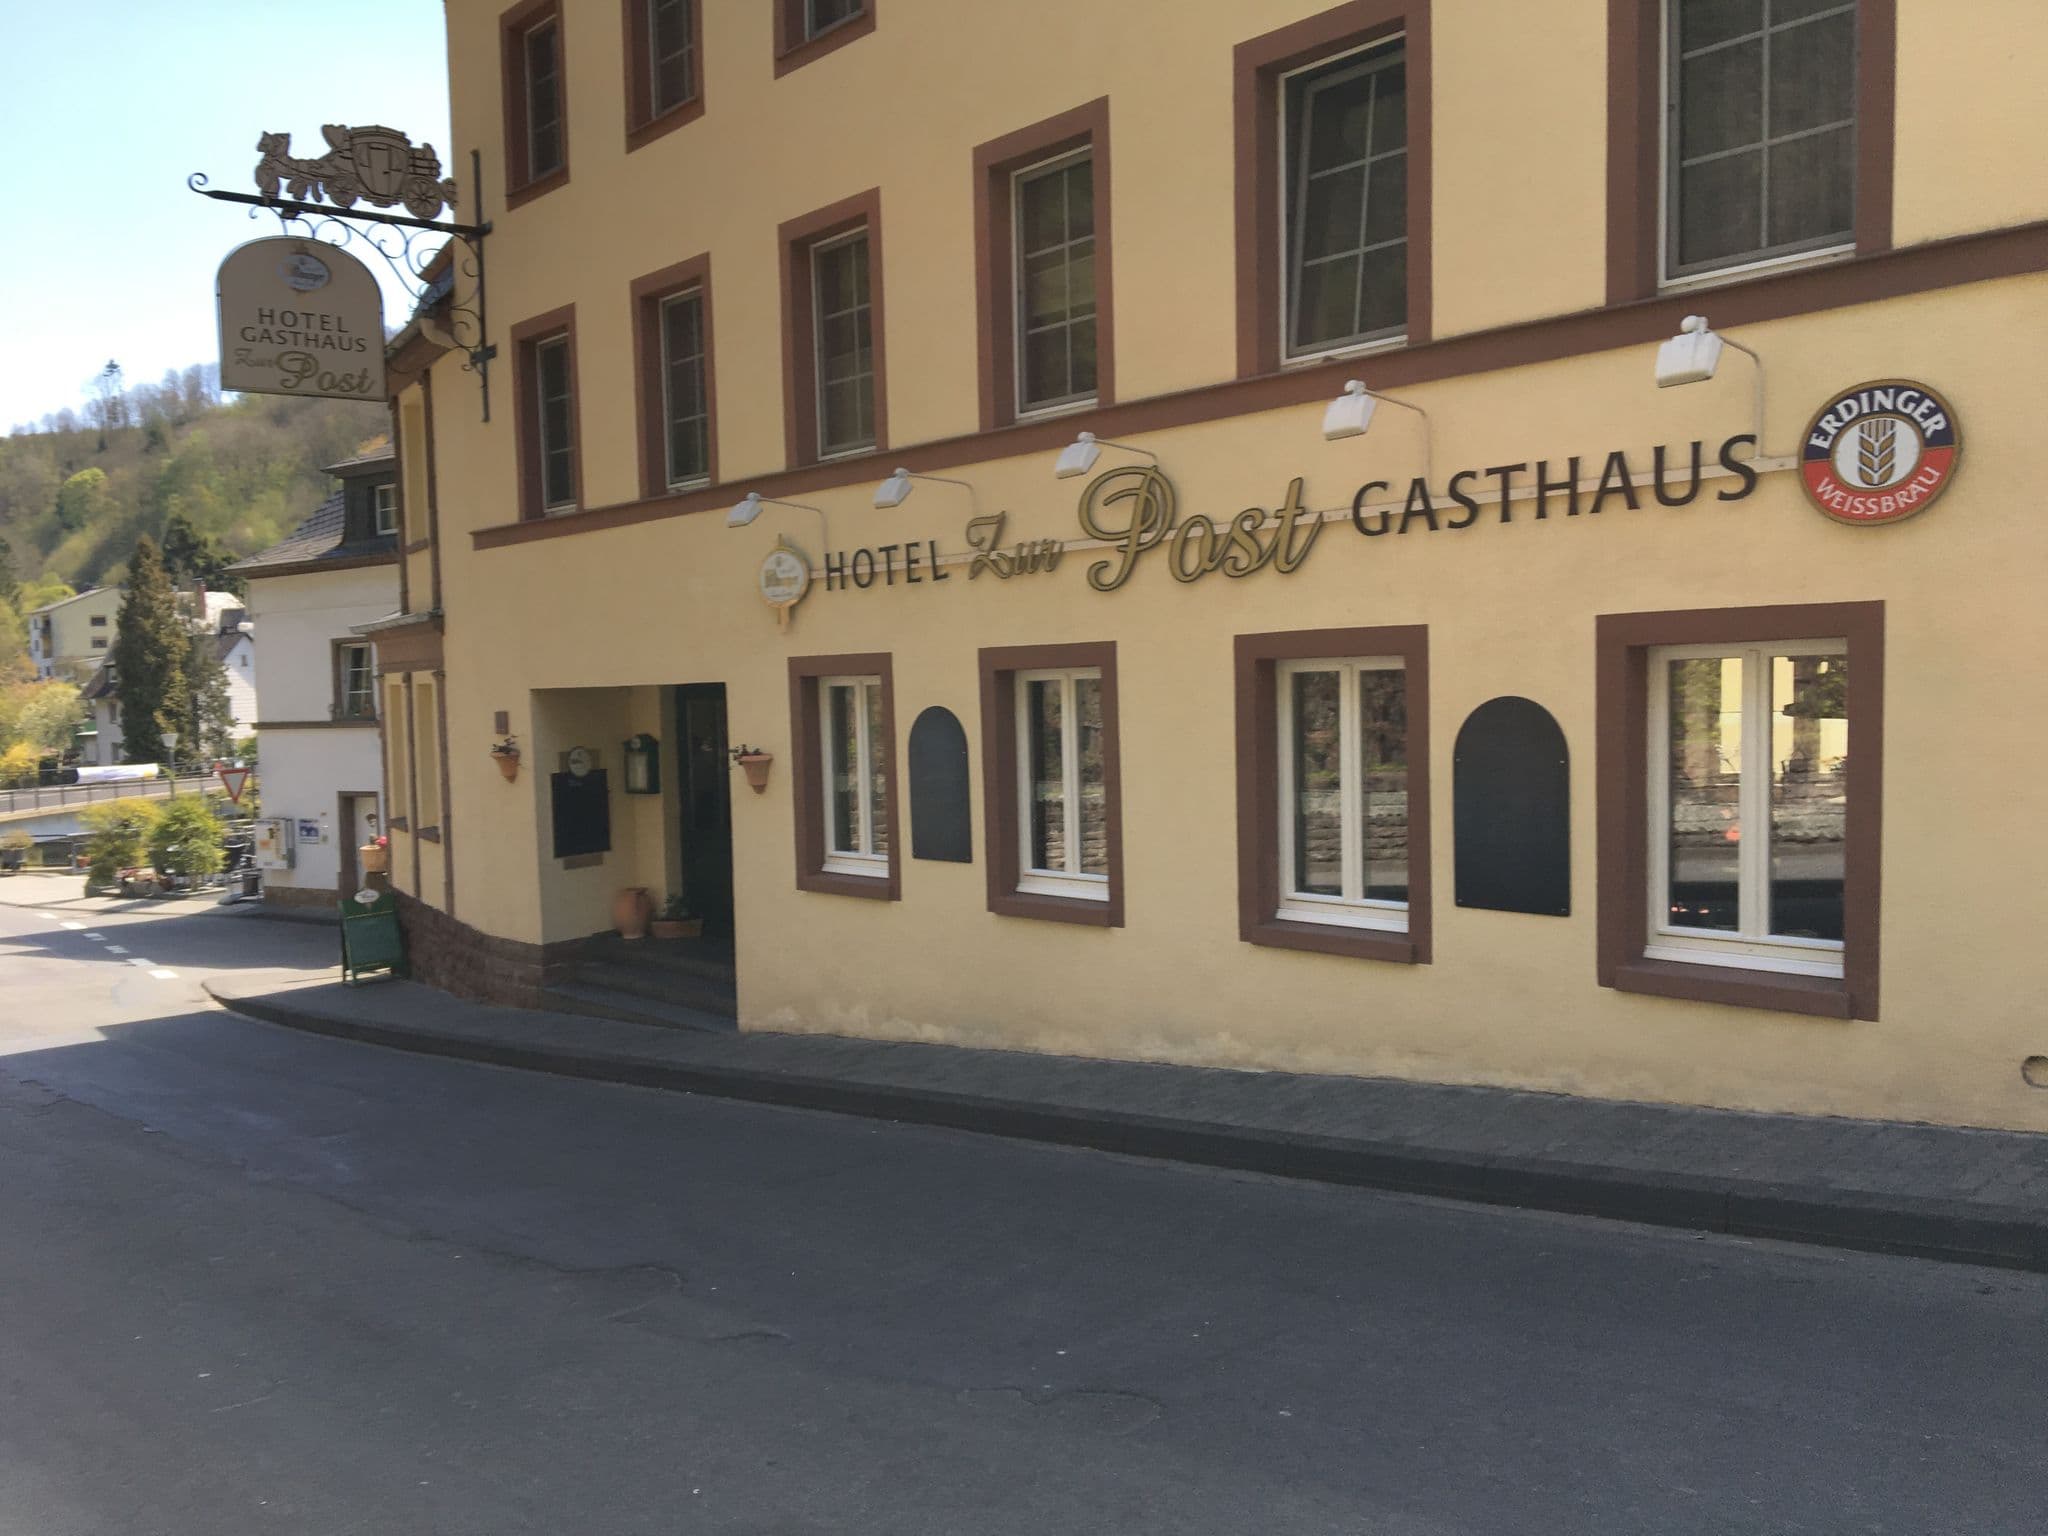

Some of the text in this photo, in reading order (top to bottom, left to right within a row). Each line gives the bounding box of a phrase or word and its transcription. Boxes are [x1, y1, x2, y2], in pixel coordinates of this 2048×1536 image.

[240, 326, 367, 353] GASTHAUS
[257, 307, 350, 334] HOTEL
[276, 350, 376, 394] Post
[1808, 388, 1947, 450] ERDINGER
[824, 539, 949, 591] HOTEL
[1077, 464, 1324, 592] Post
[1351, 433, 1759, 538] GASTHAUS
[1816, 466, 1942, 515] WEISSBRÄU
